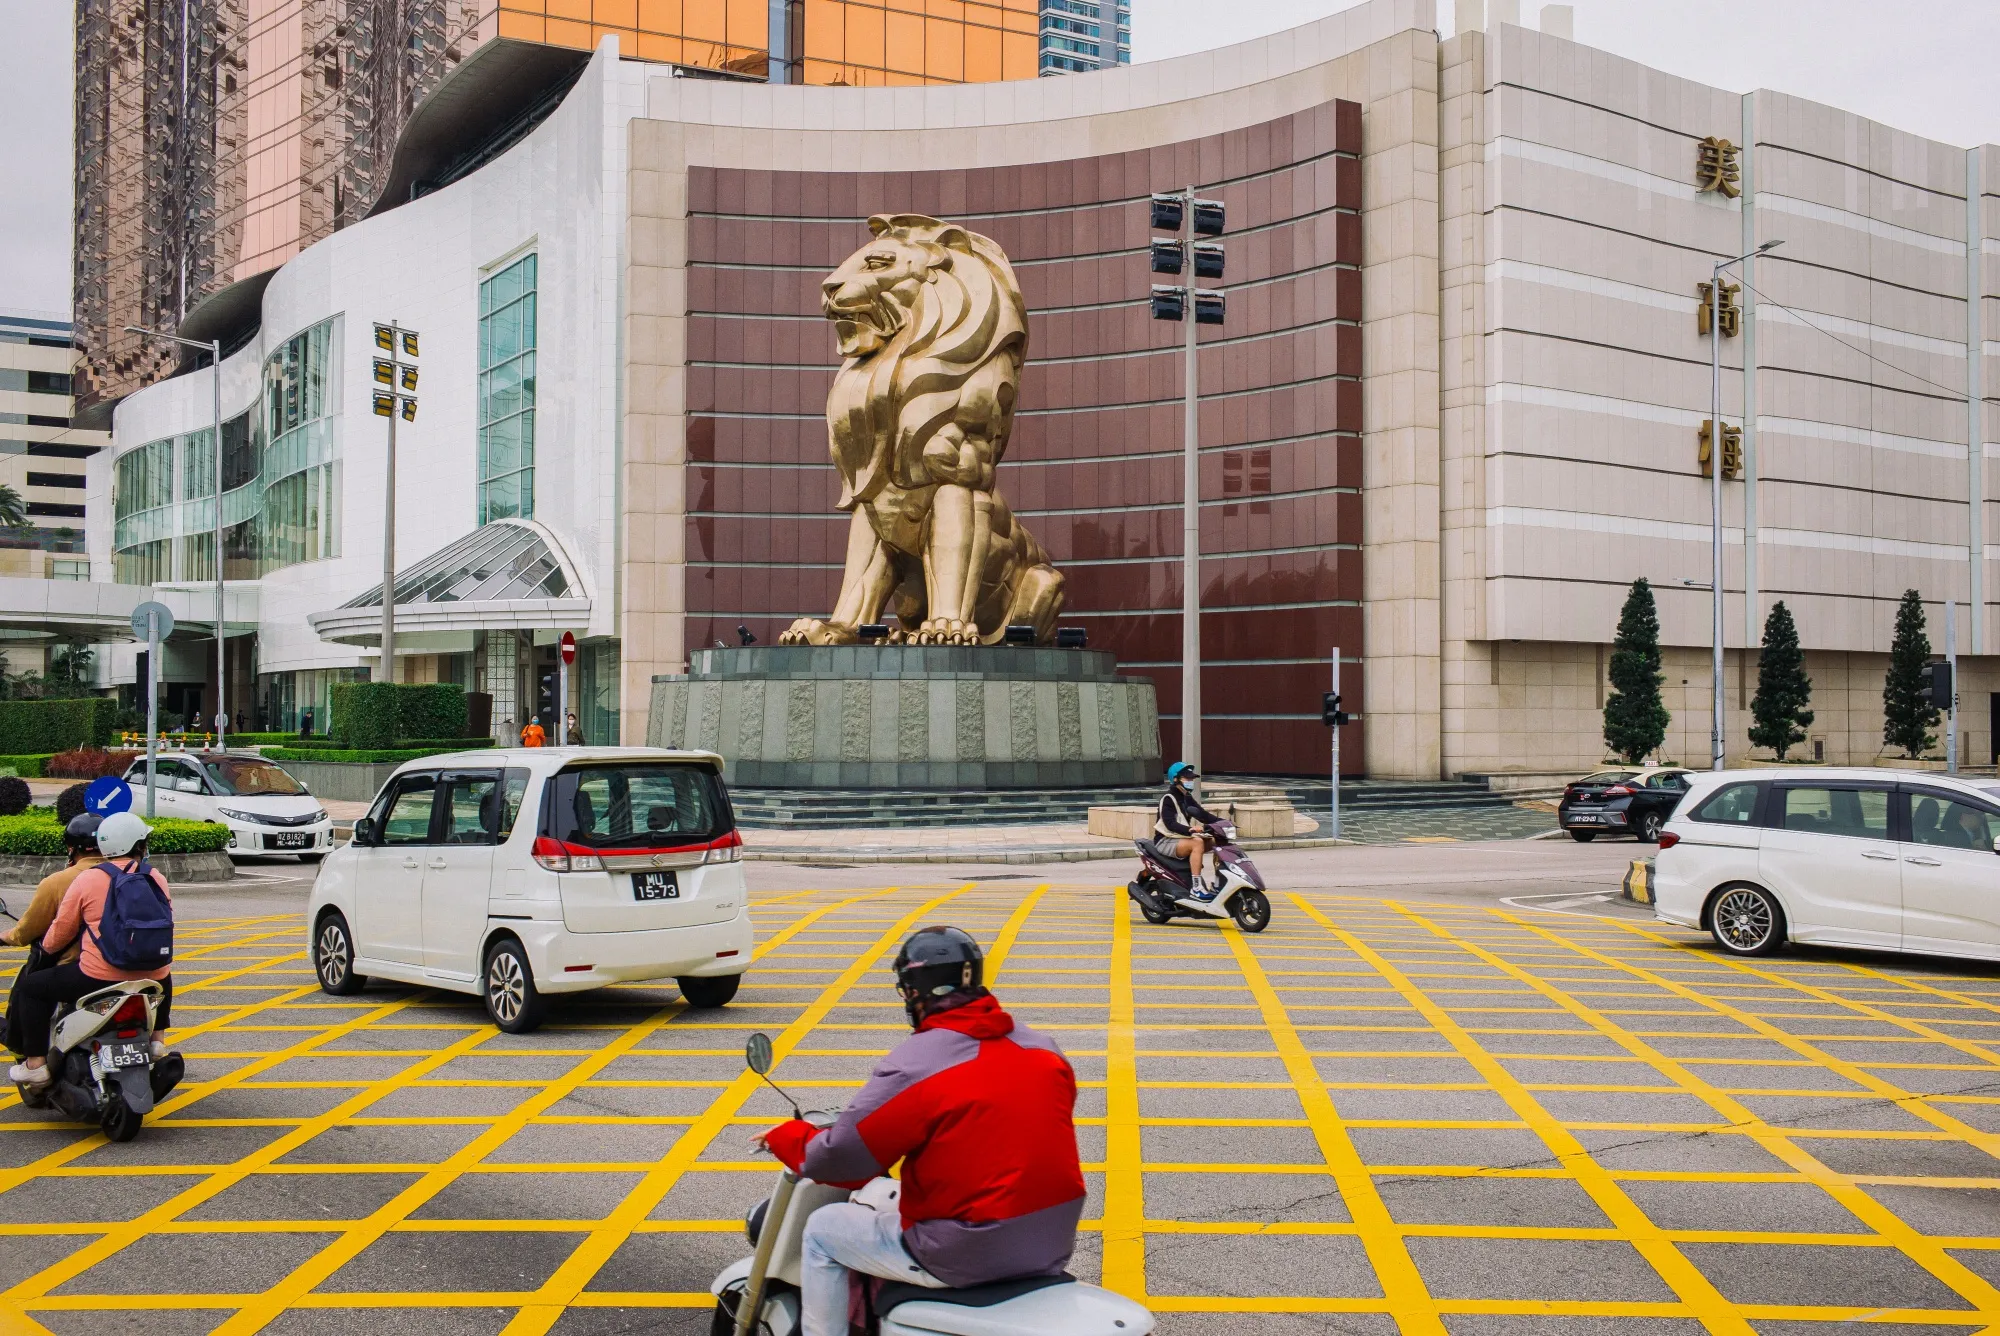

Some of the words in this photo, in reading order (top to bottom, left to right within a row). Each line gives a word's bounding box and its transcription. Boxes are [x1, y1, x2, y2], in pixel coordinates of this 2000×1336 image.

[646, 874, 664, 886] MU
[638, 885, 677, 898] 15-73
[122, 1044, 140, 1054] ML
[114, 1052, 150, 1065] 93-31
